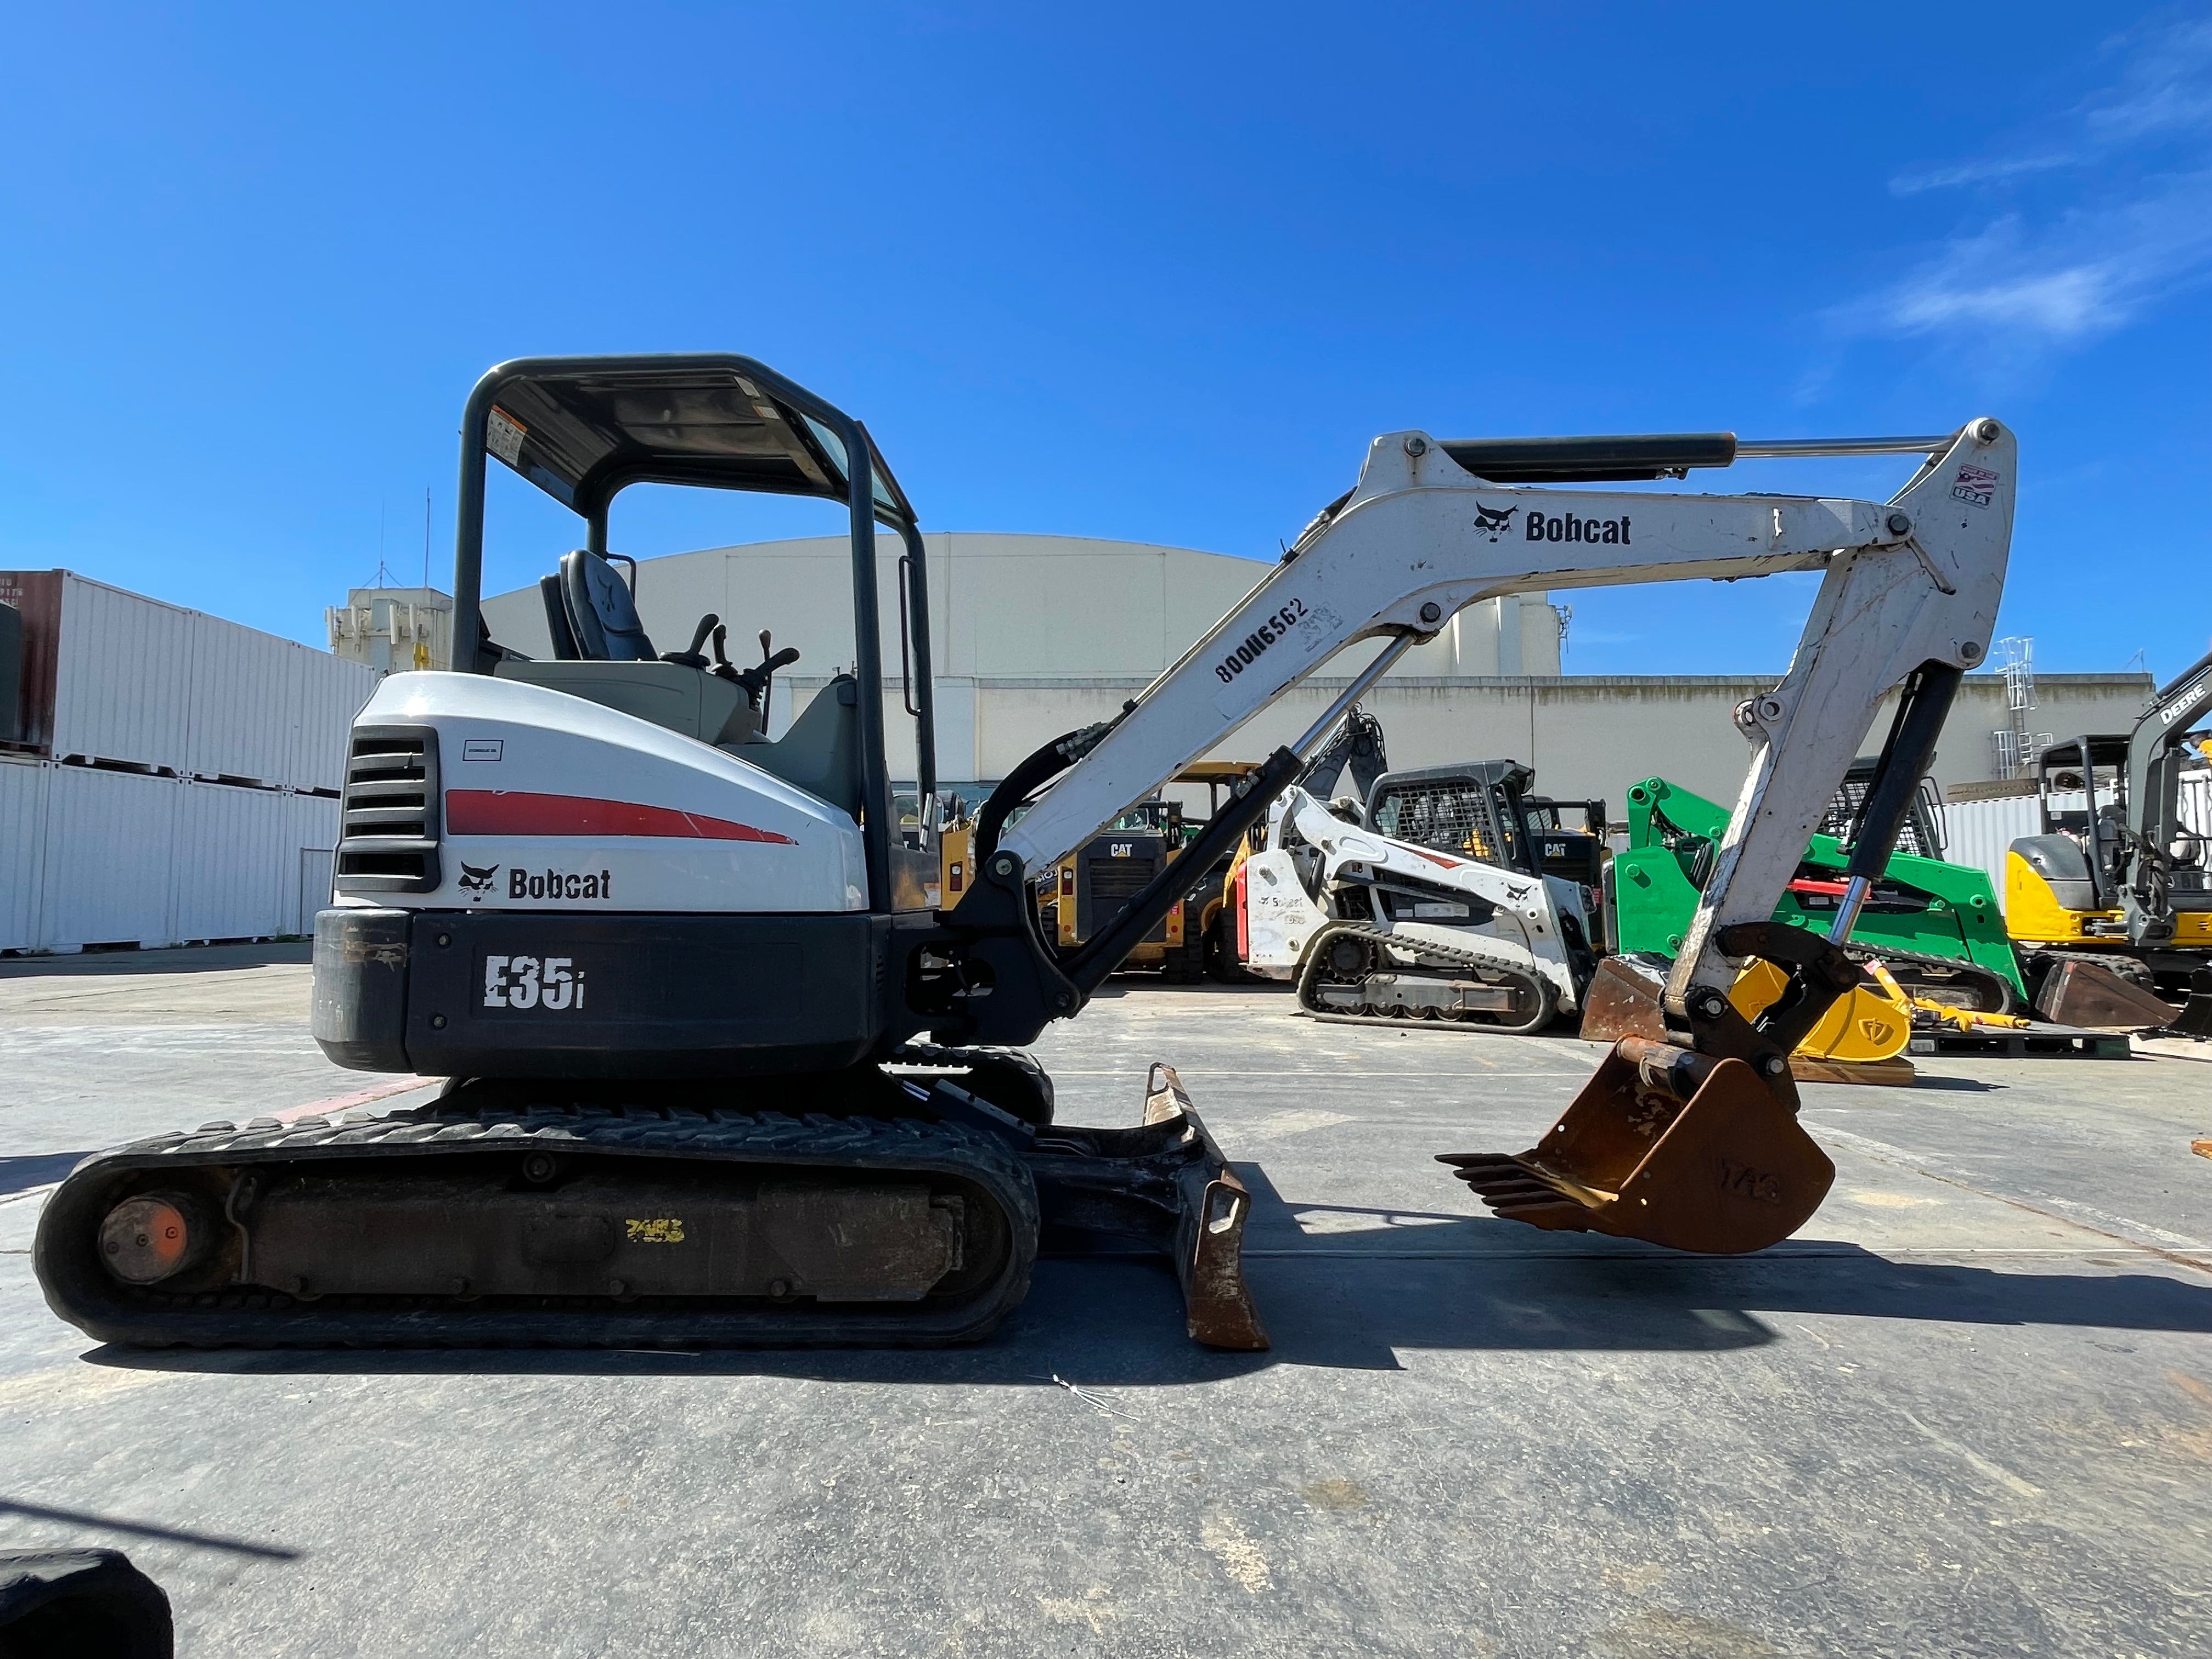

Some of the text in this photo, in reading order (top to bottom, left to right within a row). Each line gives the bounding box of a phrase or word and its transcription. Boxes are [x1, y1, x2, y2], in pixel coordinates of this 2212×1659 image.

[1954, 488, 1987, 505] USA
[1526, 511, 1631, 545] Bobcat
[1215, 598, 1308, 683] 800116562
[2160, 683, 2206, 725] DEERE
[1110, 843, 1133, 857] CAT
[1545, 843, 1566, 856] CAT
[509, 868, 611, 899] Bobcat
[483, 955, 585, 1010] E35i
